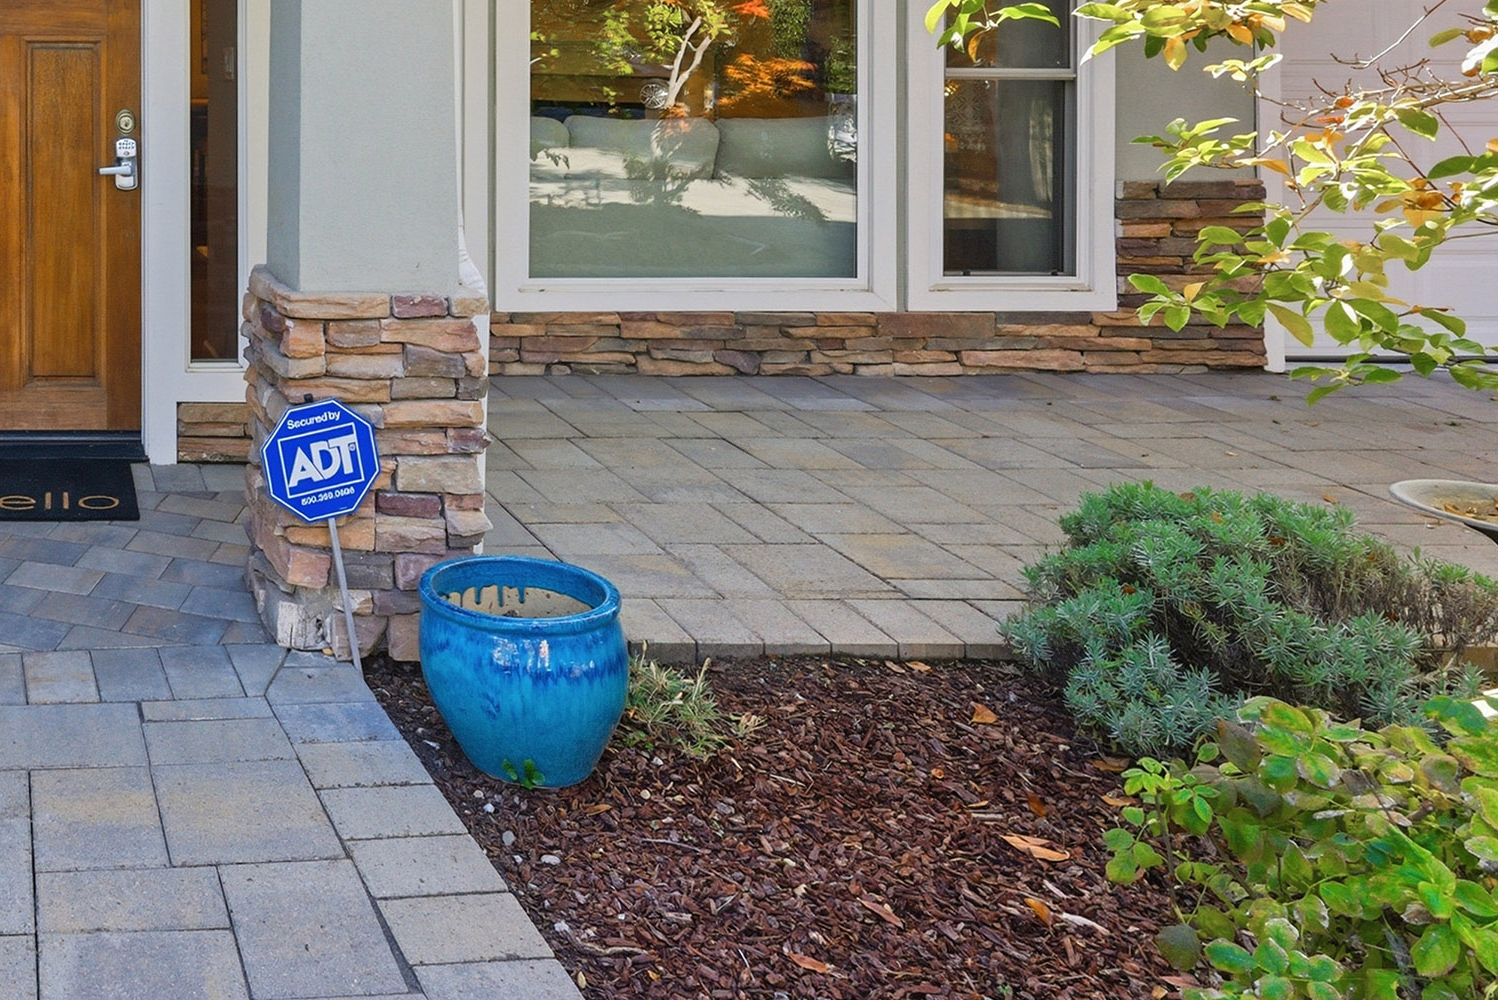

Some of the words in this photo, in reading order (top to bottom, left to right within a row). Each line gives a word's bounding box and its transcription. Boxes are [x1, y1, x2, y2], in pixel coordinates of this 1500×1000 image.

[287, 412, 328, 430] Secured
[328, 411, 341, 421] by
[288, 433, 357, 488] ADT
